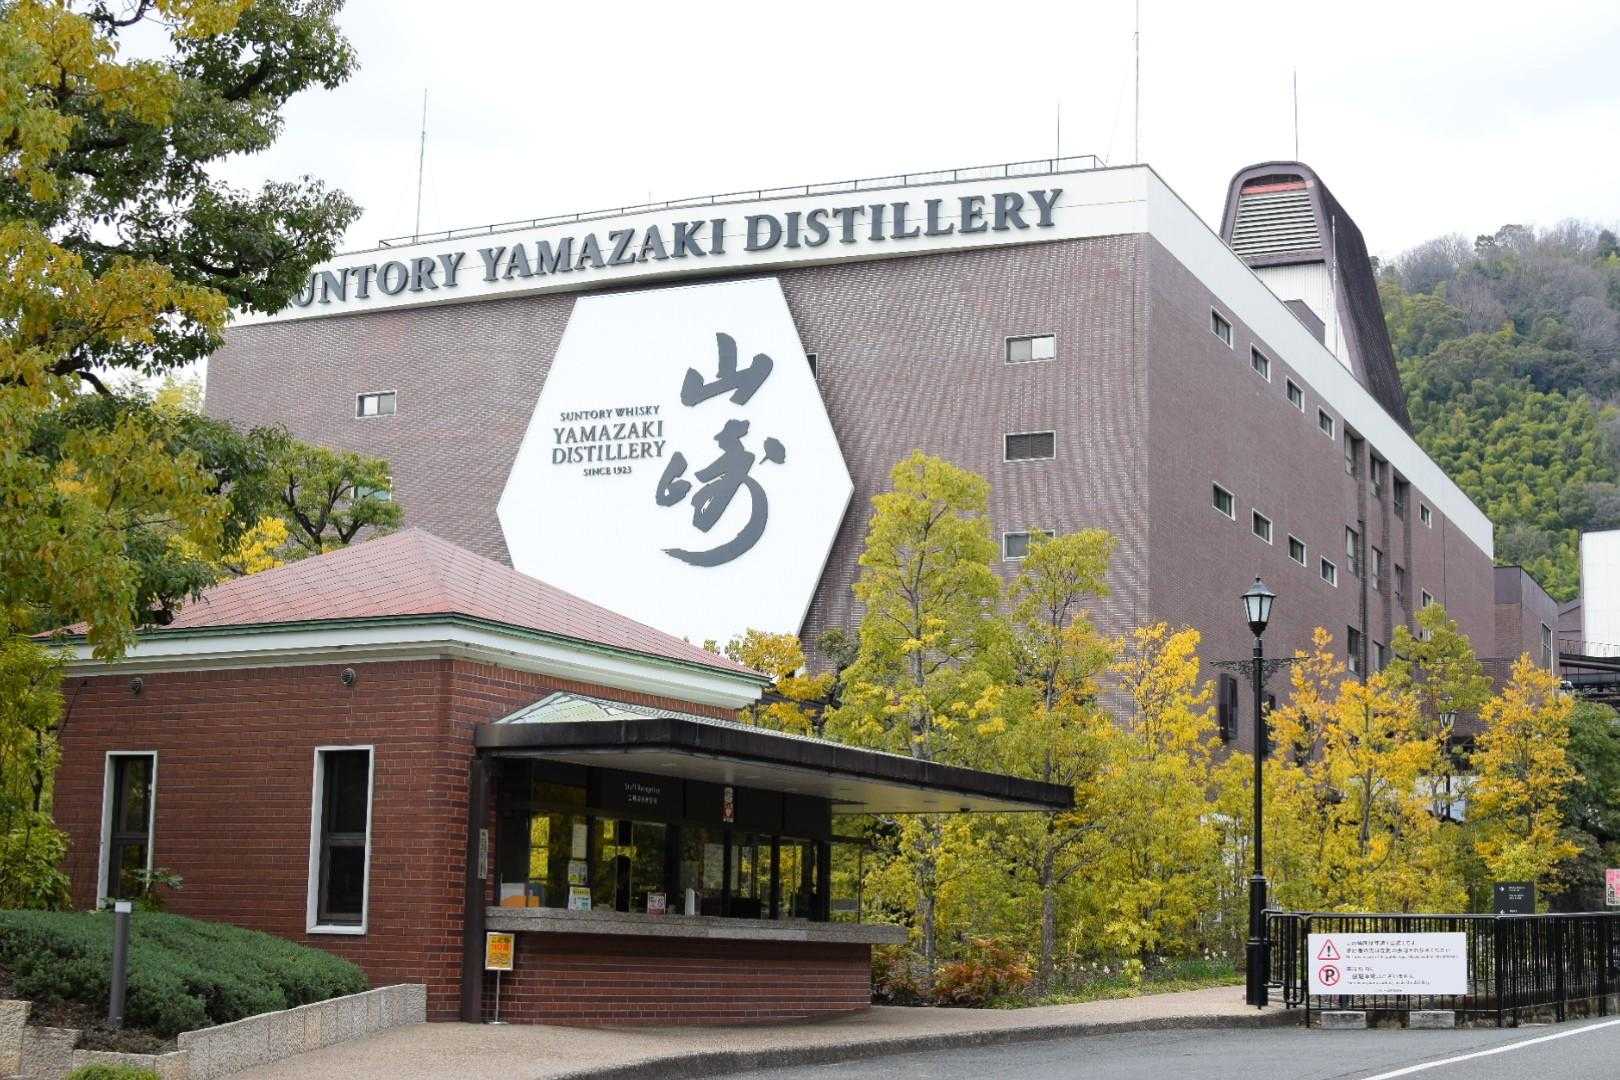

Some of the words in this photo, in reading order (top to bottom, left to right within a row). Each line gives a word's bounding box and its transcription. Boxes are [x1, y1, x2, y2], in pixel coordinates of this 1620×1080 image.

[291, 252, 466, 307] UNTORY
[478, 218, 726, 281] YAMAZAKI
[744, 188, 1063, 252] DISTILLERY
[560, 408, 612, 421] SUNTORY
[615, 405, 660, 417] WHISKY
[553, 420, 663, 445] YAMAZAKI
[552, 440, 666, 465] DISTILLERY
[583, 467, 611, 477] SINCE
[613, 465, 632, 475] 1923
